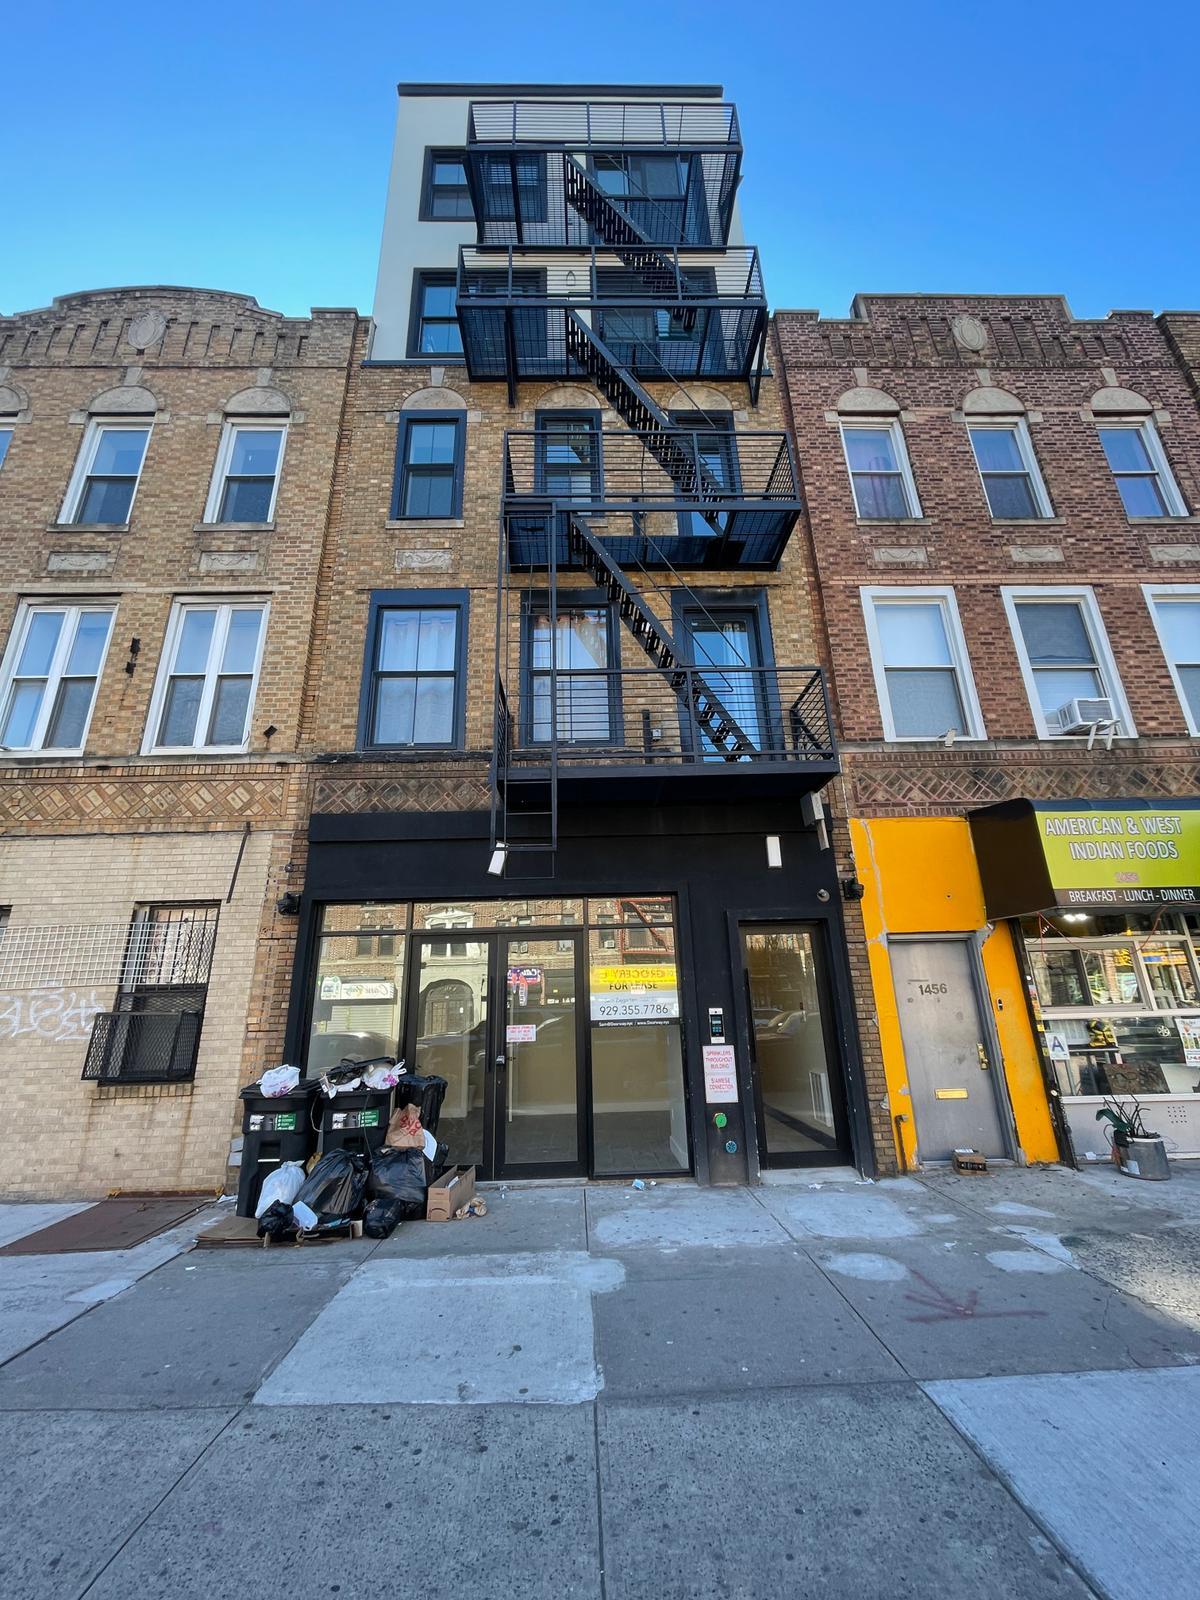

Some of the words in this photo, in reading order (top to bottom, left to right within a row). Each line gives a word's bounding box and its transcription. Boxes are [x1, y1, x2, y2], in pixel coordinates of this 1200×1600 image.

[1046, 817, 1123, 836] AMERICAN
[1126, 816, 1140, 835] &
[1141, 816, 1182, 835] WEST
[1069, 841, 1125, 860] INDIAN
[1125, 840, 1179, 860] FOODS
[1069, 890, 1118, 902] BREAKFAST
[1124, 889, 1153, 901] LUNCH
[1161, 889, 1196, 901] DINNER
[609, 981, 628, 991] FOR
[630, 981, 659, 991] ASE
[918, 983, 948, 996] 1456
[599, 1004, 669, 1017] 929.355.7786
[1051, 1036, 1065, 1052] A
